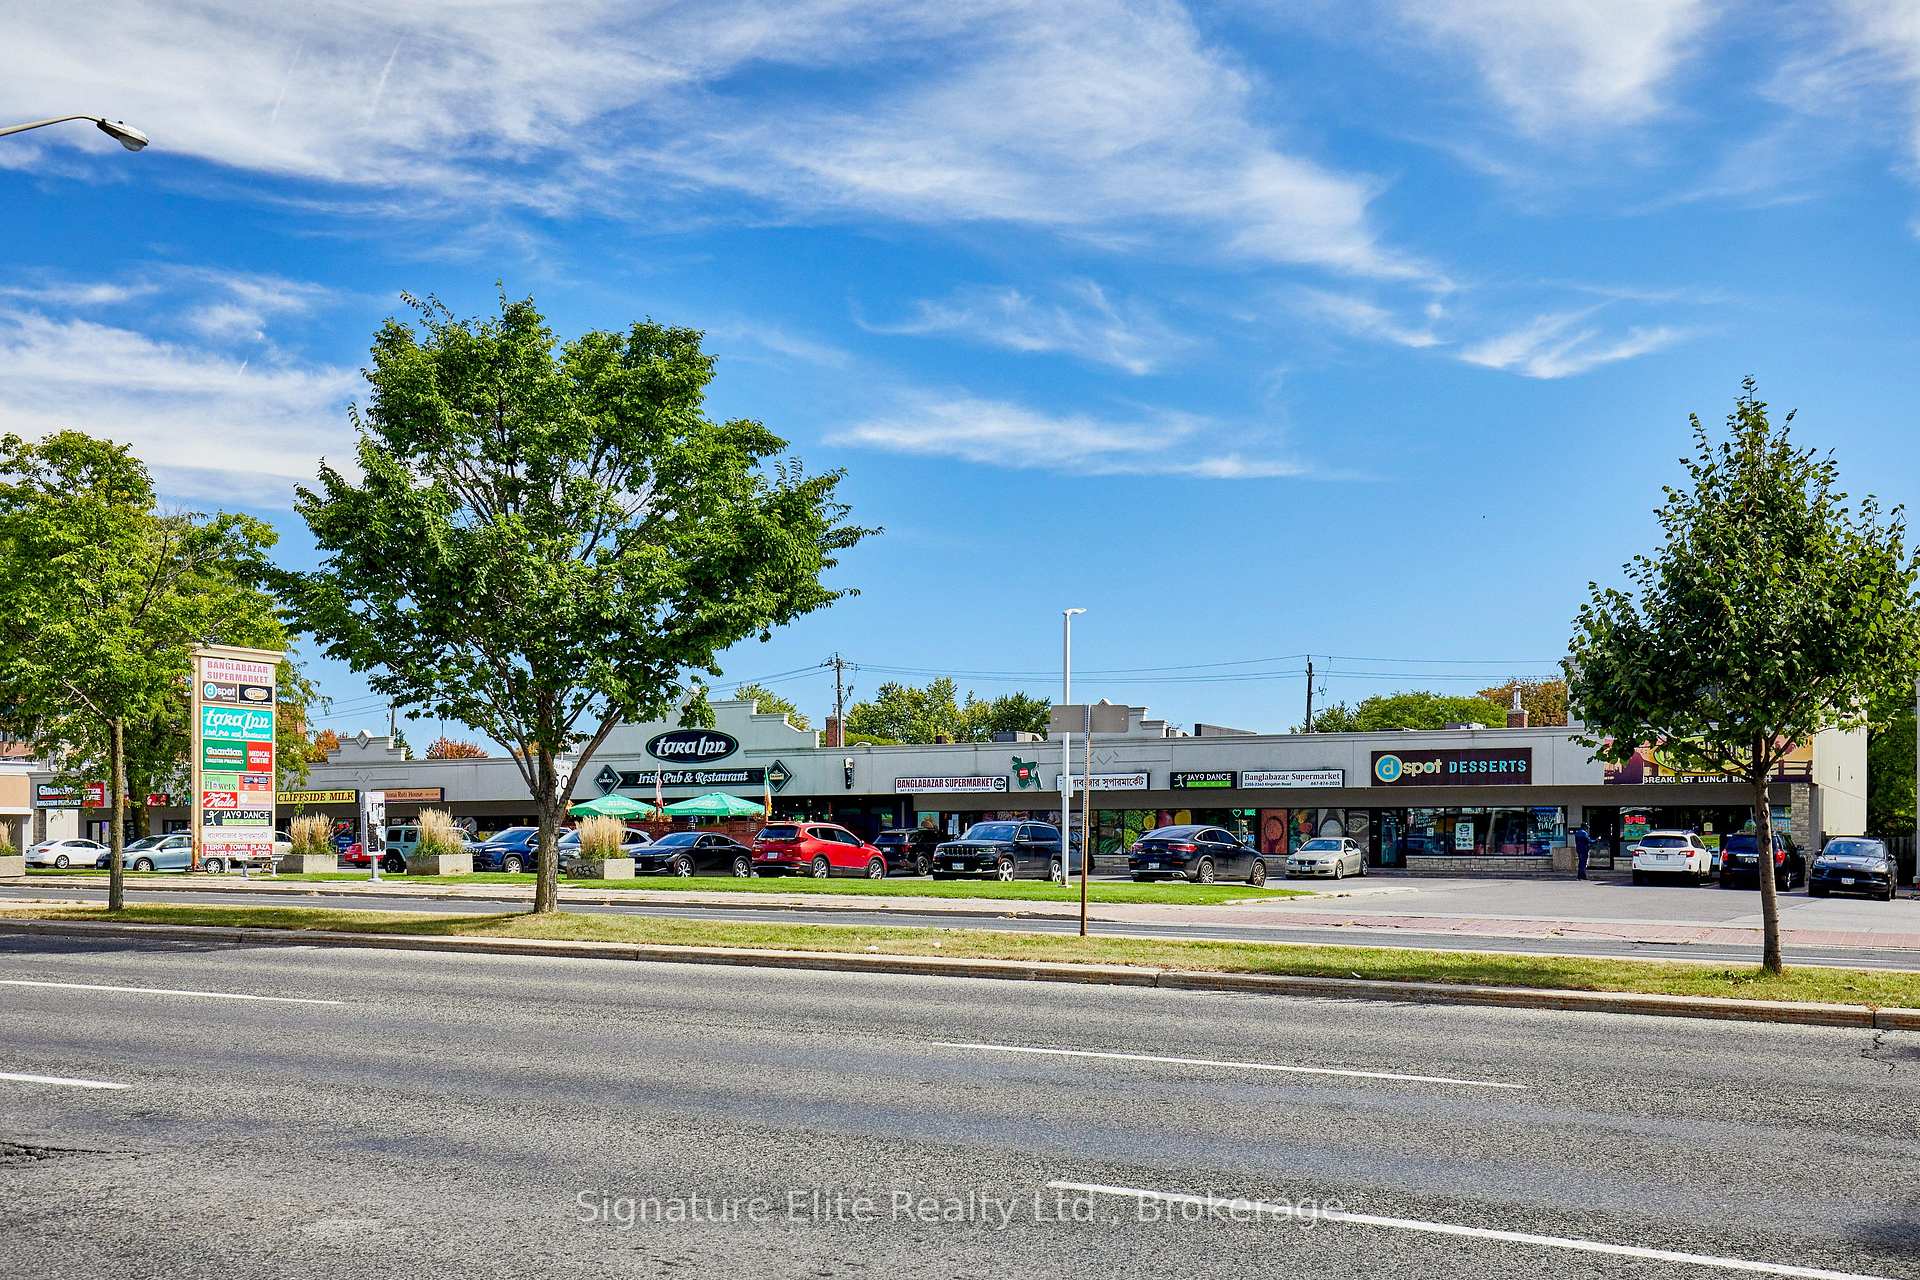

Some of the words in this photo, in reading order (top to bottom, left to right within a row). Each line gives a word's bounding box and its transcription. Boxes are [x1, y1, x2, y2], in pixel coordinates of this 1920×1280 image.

[207, 661, 268, 673] BANGLABAZAR
[207, 671, 269, 683] SUPERMARKET
[1449, 760, 1527, 773] DESSERTS
[663, 773, 683, 784] Pub
[684, 772, 694, 783] &
[695, 771, 749, 784] Restaurant
[897, 778, 944, 788] BANGLABAZAR
[945, 777, 993, 788] SUPERMARKET
[1206, 773, 1232, 781] DANCE
[1244, 773, 1289, 782] Banglabazar
[1291, 772, 1340, 782] Supermarket
[1698, 775, 1728, 783] LUNCH
[277, 792, 326, 802] CLIFFSIDE
[329, 791, 354, 801] MILK
[244, 811, 269, 819] DANCE
